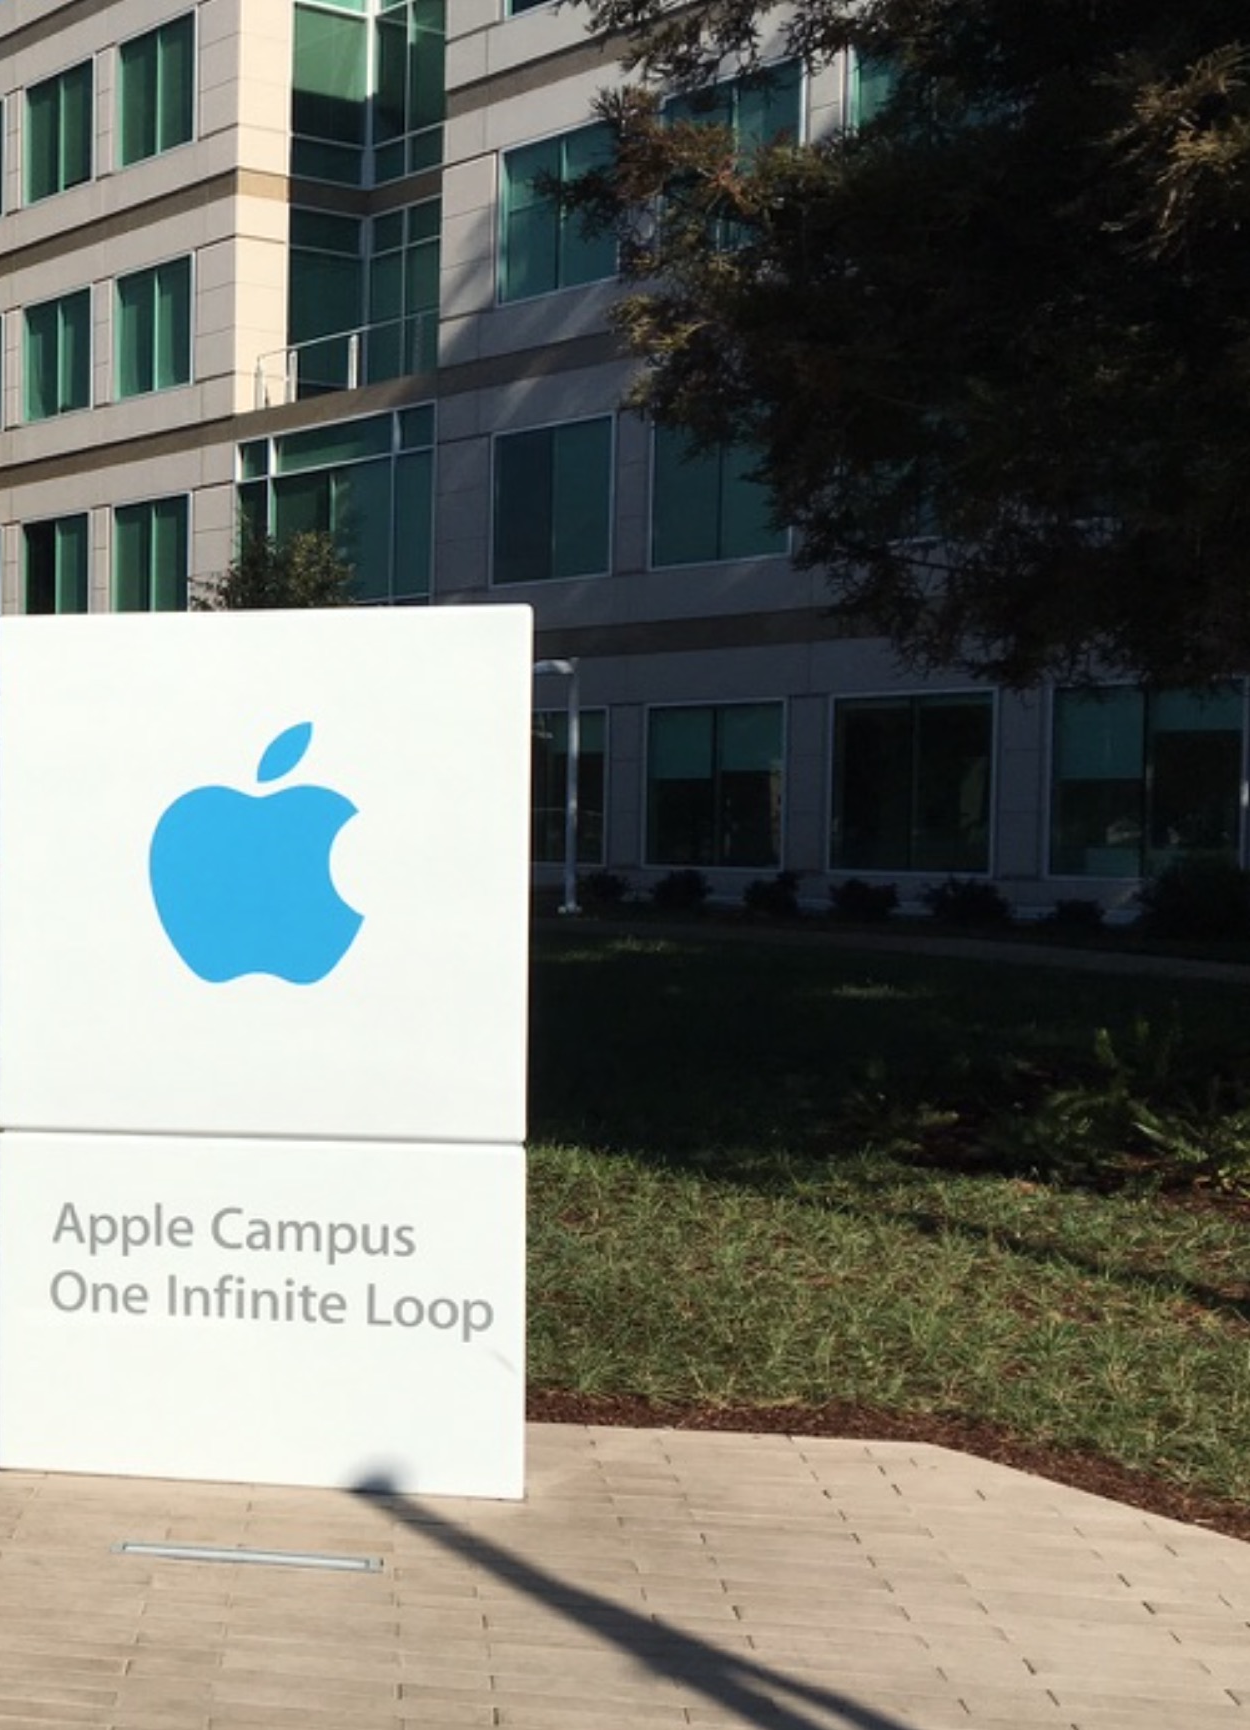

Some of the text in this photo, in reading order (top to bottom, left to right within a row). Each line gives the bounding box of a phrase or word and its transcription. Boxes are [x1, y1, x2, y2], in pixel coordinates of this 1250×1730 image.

[52, 1202, 416, 1265] Apple Campus
[50, 1270, 494, 1342] One Infinite Loop
